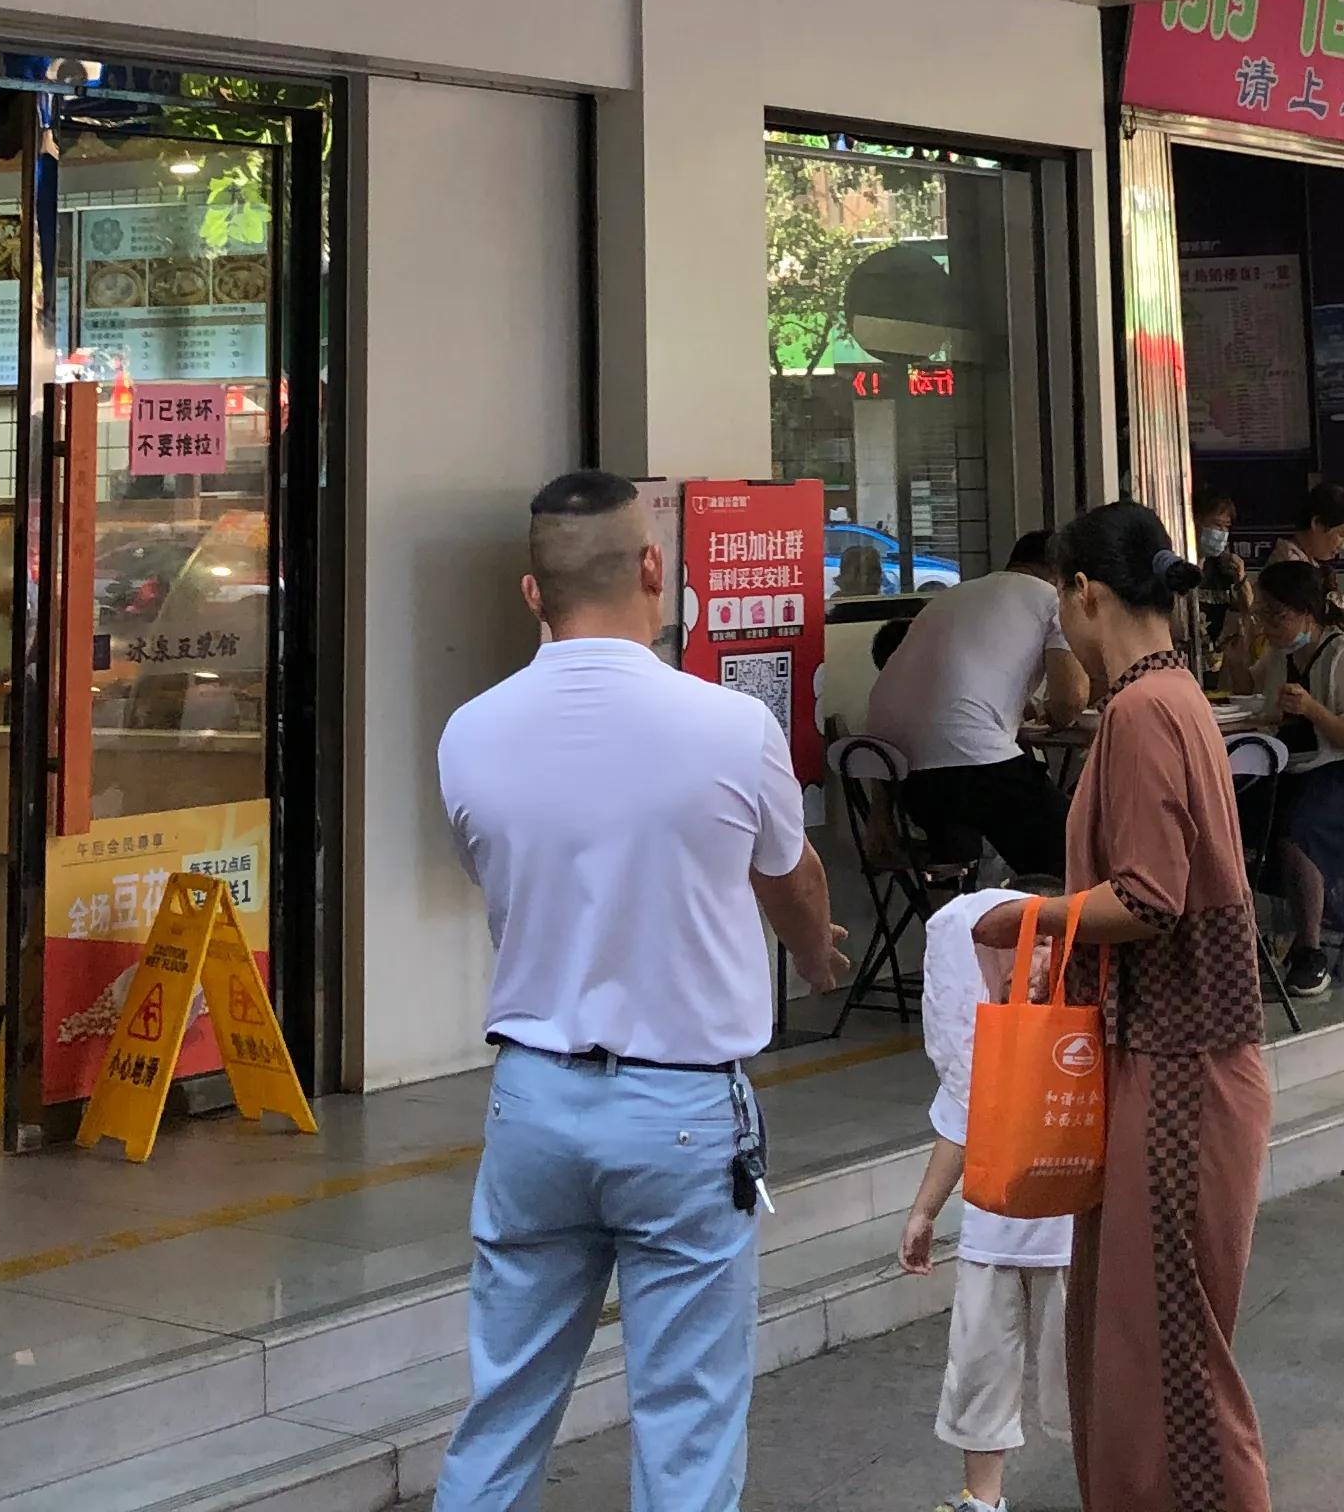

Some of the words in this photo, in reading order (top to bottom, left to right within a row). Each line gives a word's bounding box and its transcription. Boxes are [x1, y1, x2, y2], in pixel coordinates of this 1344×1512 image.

[708, 529, 804, 563] 扫码加社群
[708, 565, 804, 592] 福利妥妥安排上
[189, 854, 251, 876] 每天12点后
